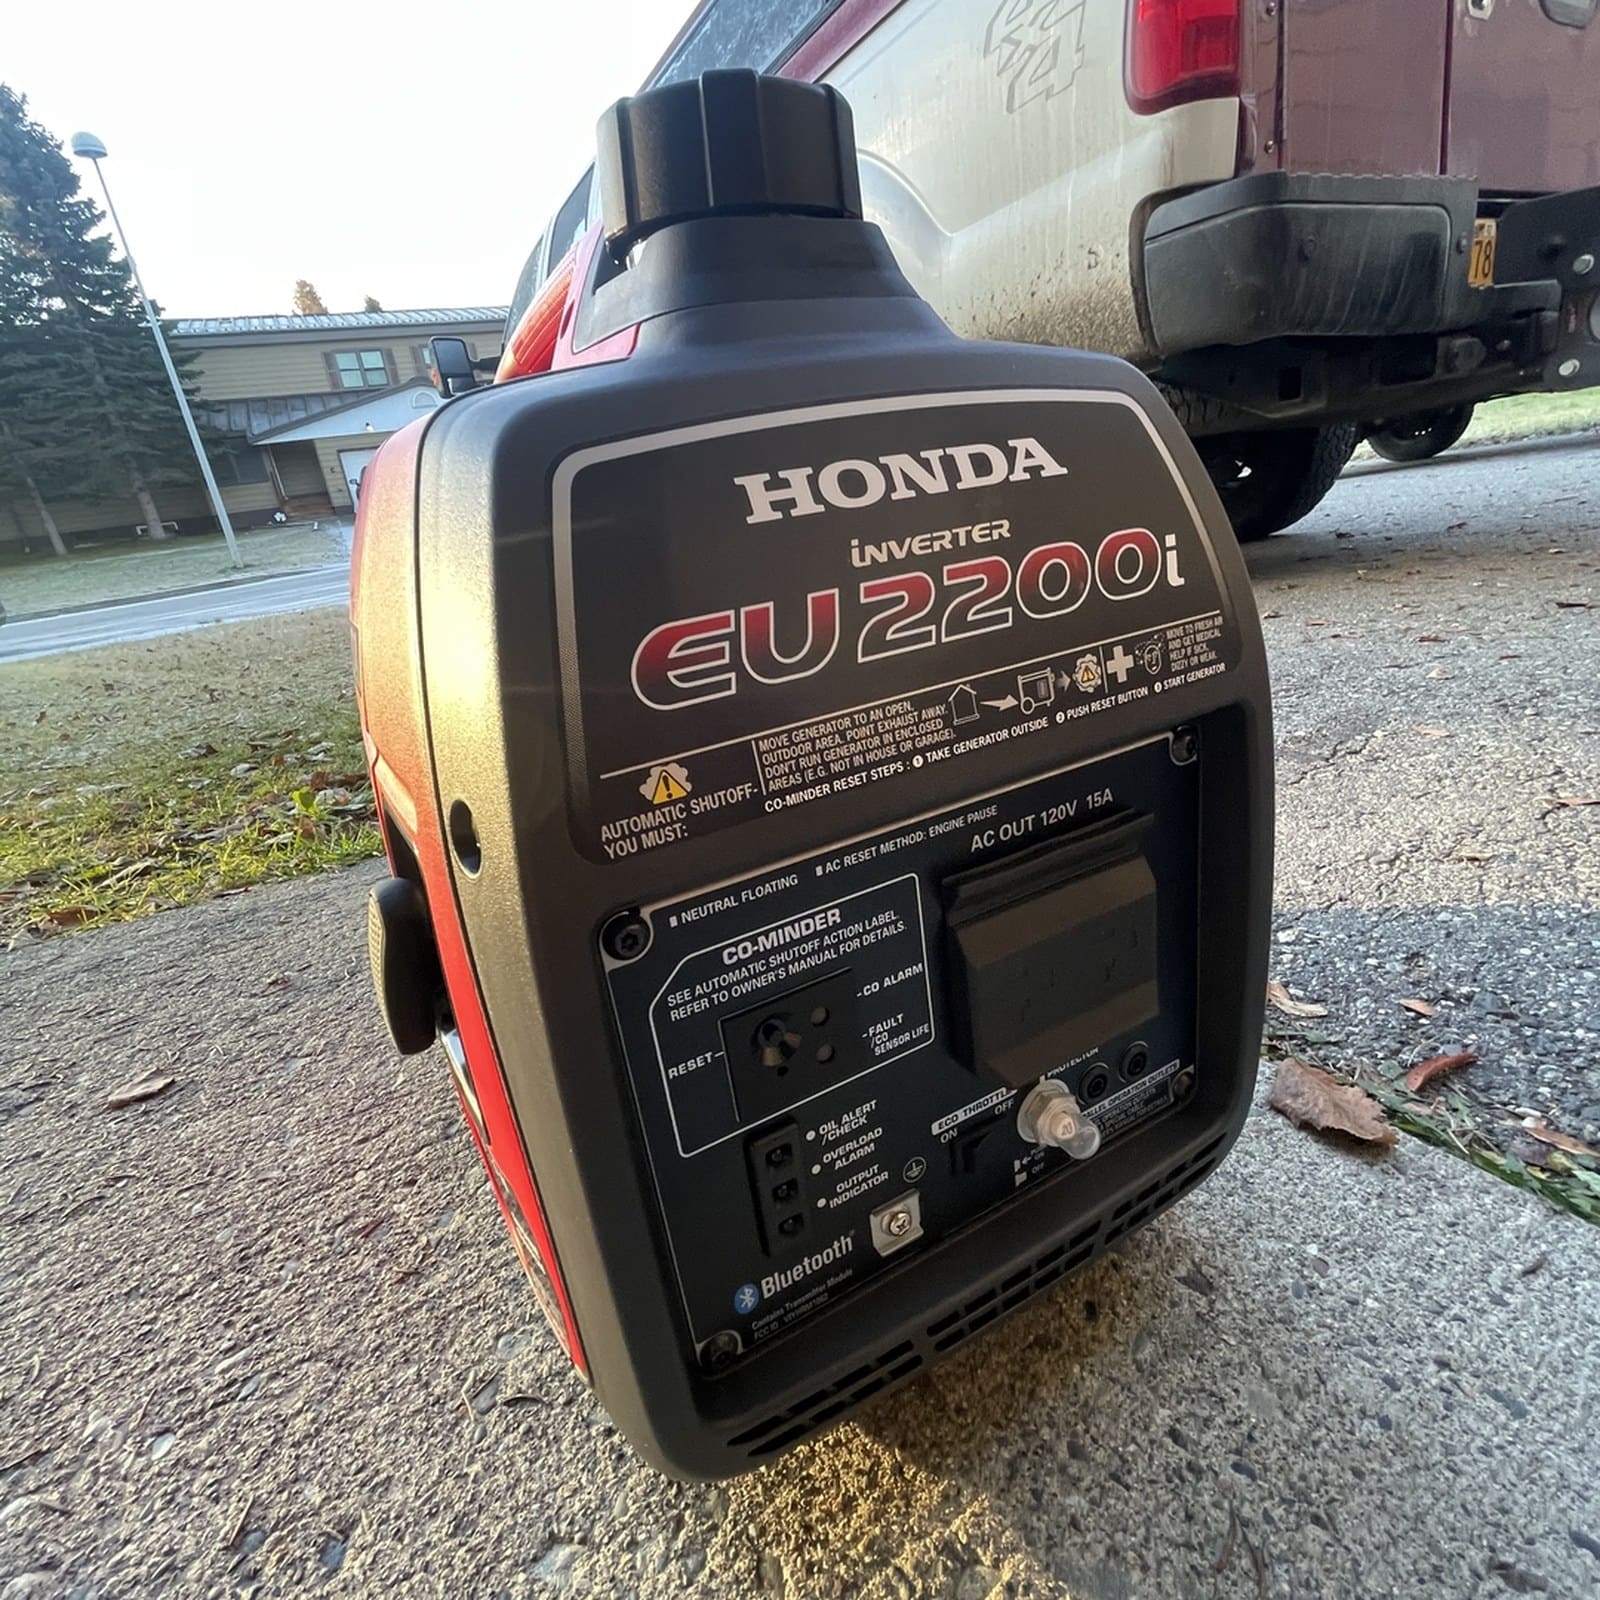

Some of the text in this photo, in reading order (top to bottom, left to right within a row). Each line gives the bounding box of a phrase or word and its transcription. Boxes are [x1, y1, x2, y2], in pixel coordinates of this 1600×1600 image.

[734, 438, 1067, 523] HONDA
[1166, 626, 1184, 639] MOVE
[1194, 619, 1213, 632] FRESH
[1169, 628, 1221, 650] AND GET MEDICAL
[1170, 648, 1186, 661] HELP
[1171, 659, 1188, 672] DIZZY
[1189, 656, 1199, 666] OR
[758, 734, 790, 752] MOVE
[792, 718, 851, 744] GENERATOR
[853, 713, 868, 726] TO
[870, 708, 884, 721] AN
[762, 743, 812, 765] OUTDOOR
[847, 727, 875, 746] POINT
[878, 714, 920, 734] EXHAUST
[764, 783, 831, 814] CO-MINDER
[834, 772, 867, 792] RESET
[925, 745, 952, 763] TAKE
[953, 728, 1010, 756] GENERATOR
[1010, 716, 1049, 738] OUTSIDE
[1066, 703, 1090, 720] PUSH
[1091, 695, 1117, 714] RESET
[1118, 686, 1149, 707] BUTTON
[1163, 675, 1185, 690] START
[1186, 662, 1226, 682] GENERATOR
[765, 718, 944, 779] DON'T RUN GENERATOR IN ENCLOSED
[768, 728, 956, 792] AREAS (E.G. NOT IN HOUSE OR GARAGE).
[600, 802, 687, 842] AUTOMATIC
[971, 787, 1114, 852] AC OUT 120V 15A
[604, 822, 689, 861] YOU MUST:
[681, 804, 999, 924] NEUTRAL FLOATING AC RESET METHOD: ENGINE PAUSE
[722, 908, 842, 966] CO-MINDER
[667, 991, 692, 1008] SEE
[694, 960, 767, 997] AUTOMATIC
[768, 939, 821, 969] SHUTOFF
[823, 925, 865, 950] ACTION
[670, 999, 710, 1022] REFER
[711, 991, 730, 1007] TO
[731, 968, 787, 998] OWNER'S
[788, 948, 839, 977] MANUAL
[839, 939, 861, 957] FOR
[882, 962, 923, 988] ALARM
[870, 1031, 889, 1048] /CO
[874, 1024, 930, 1056] SENSOR LIFE
[668, 1054, 713, 1080] RESET
[818, 1100, 877, 1136] OIL ALERT
[821, 1115, 868, 1146] /CHECK
[938, 1114, 959, 1131] ECO
[940, 1099, 1014, 1143] ON OFF
[822, 1127, 883, 1164] OVERLOAD
[834, 1143, 876, 1170] ALARM
[829, 1171, 889, 1209] INDICATOR
[835, 1164, 880, 1193] OUTPUT
[751, 1307, 784, 1330] Contains
